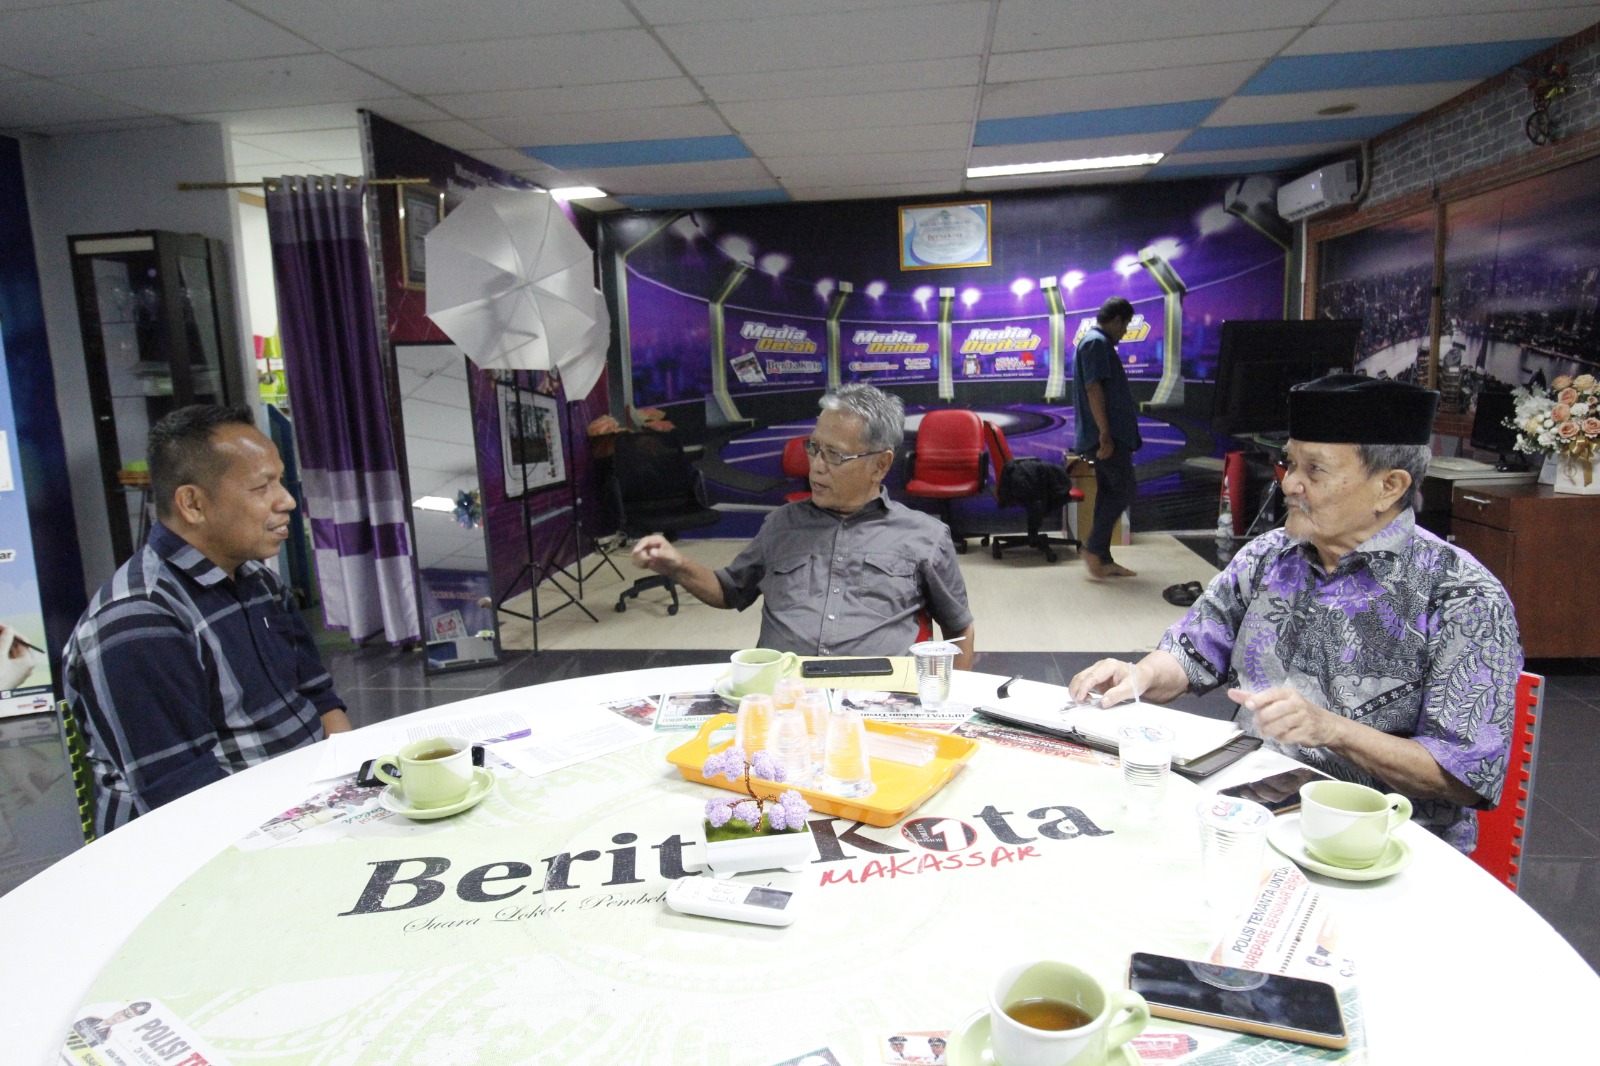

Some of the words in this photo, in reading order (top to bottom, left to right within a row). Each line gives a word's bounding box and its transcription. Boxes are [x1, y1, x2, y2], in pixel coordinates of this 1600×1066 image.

[741, 323, 806, 340] Media
[853, 331, 917, 344] Media
[969, 326, 1031, 341] Media
[867, 342, 928, 353] Online
[961, 335, 1040, 354] Digital
[337, 832, 706, 917] Berit
[820, 846, 1042, 887] MAKASSAR
[403, 915, 481, 936] Suara
[1232, 926, 1254, 954] POLISI
[1247, 891, 1275, 932] TEMANTA
[133, 1017, 192, 1061] POLISI
